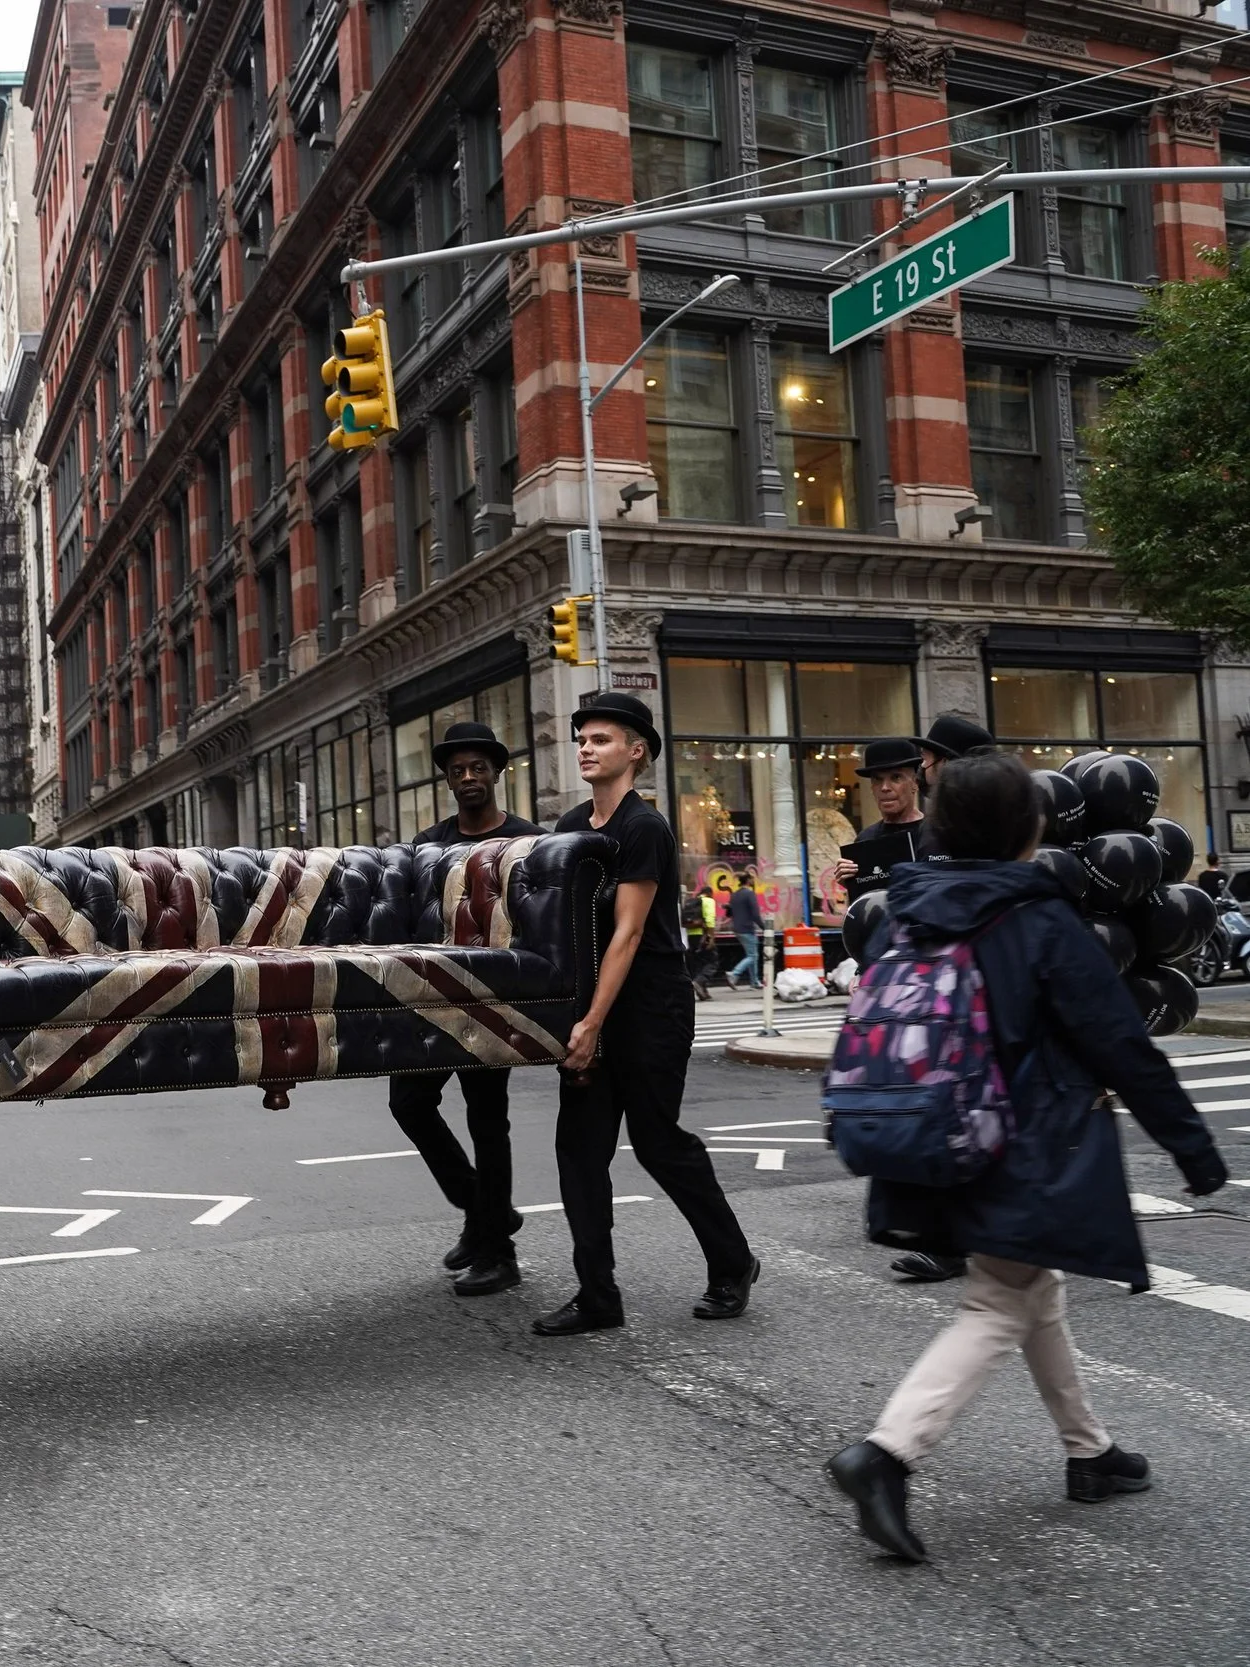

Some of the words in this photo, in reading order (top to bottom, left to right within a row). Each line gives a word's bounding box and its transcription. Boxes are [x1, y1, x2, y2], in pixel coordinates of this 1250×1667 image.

[872, 279, 884, 316] E
[895, 261, 920, 302] 19
[932, 240, 957, 284] St
[612, 674, 653, 689] Broadway
[856, 874, 879, 884] TIMOTHY
[1090, 865, 1121, 888] BROADWAY
